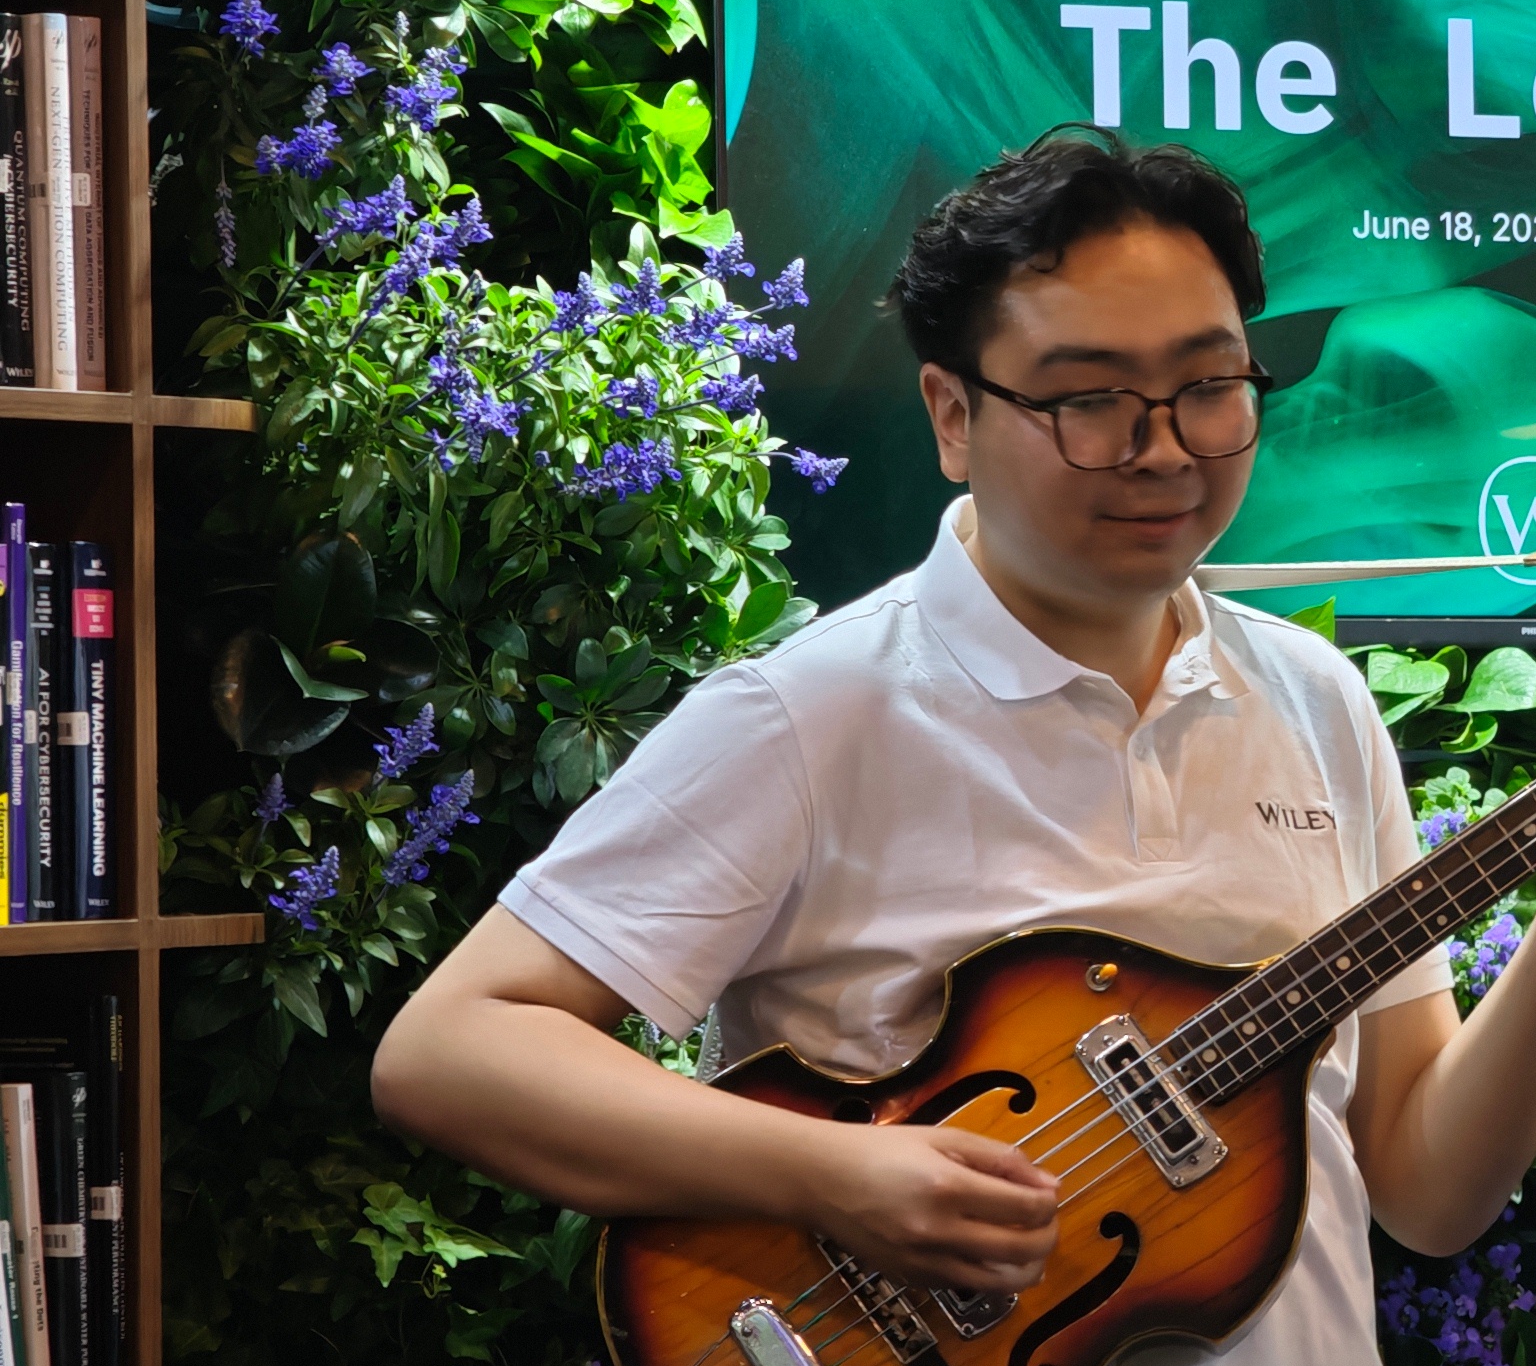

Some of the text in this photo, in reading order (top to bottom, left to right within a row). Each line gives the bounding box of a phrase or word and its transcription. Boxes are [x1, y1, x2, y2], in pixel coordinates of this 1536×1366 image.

[1060, 1, 1337, 134] The
[14, 130, 31, 331] QUANTUM COMPUTING
[51, 86, 69, 351] NEXT-GENTION COMPUTING
[1352, 210, 1430, 241] June
[1439, 211, 1482, 247] 18,
[38, 667, 51, 868] AI FOR CYBERSECURITY
[91, 659, 106, 877] TINY MACHINE LEARNING
